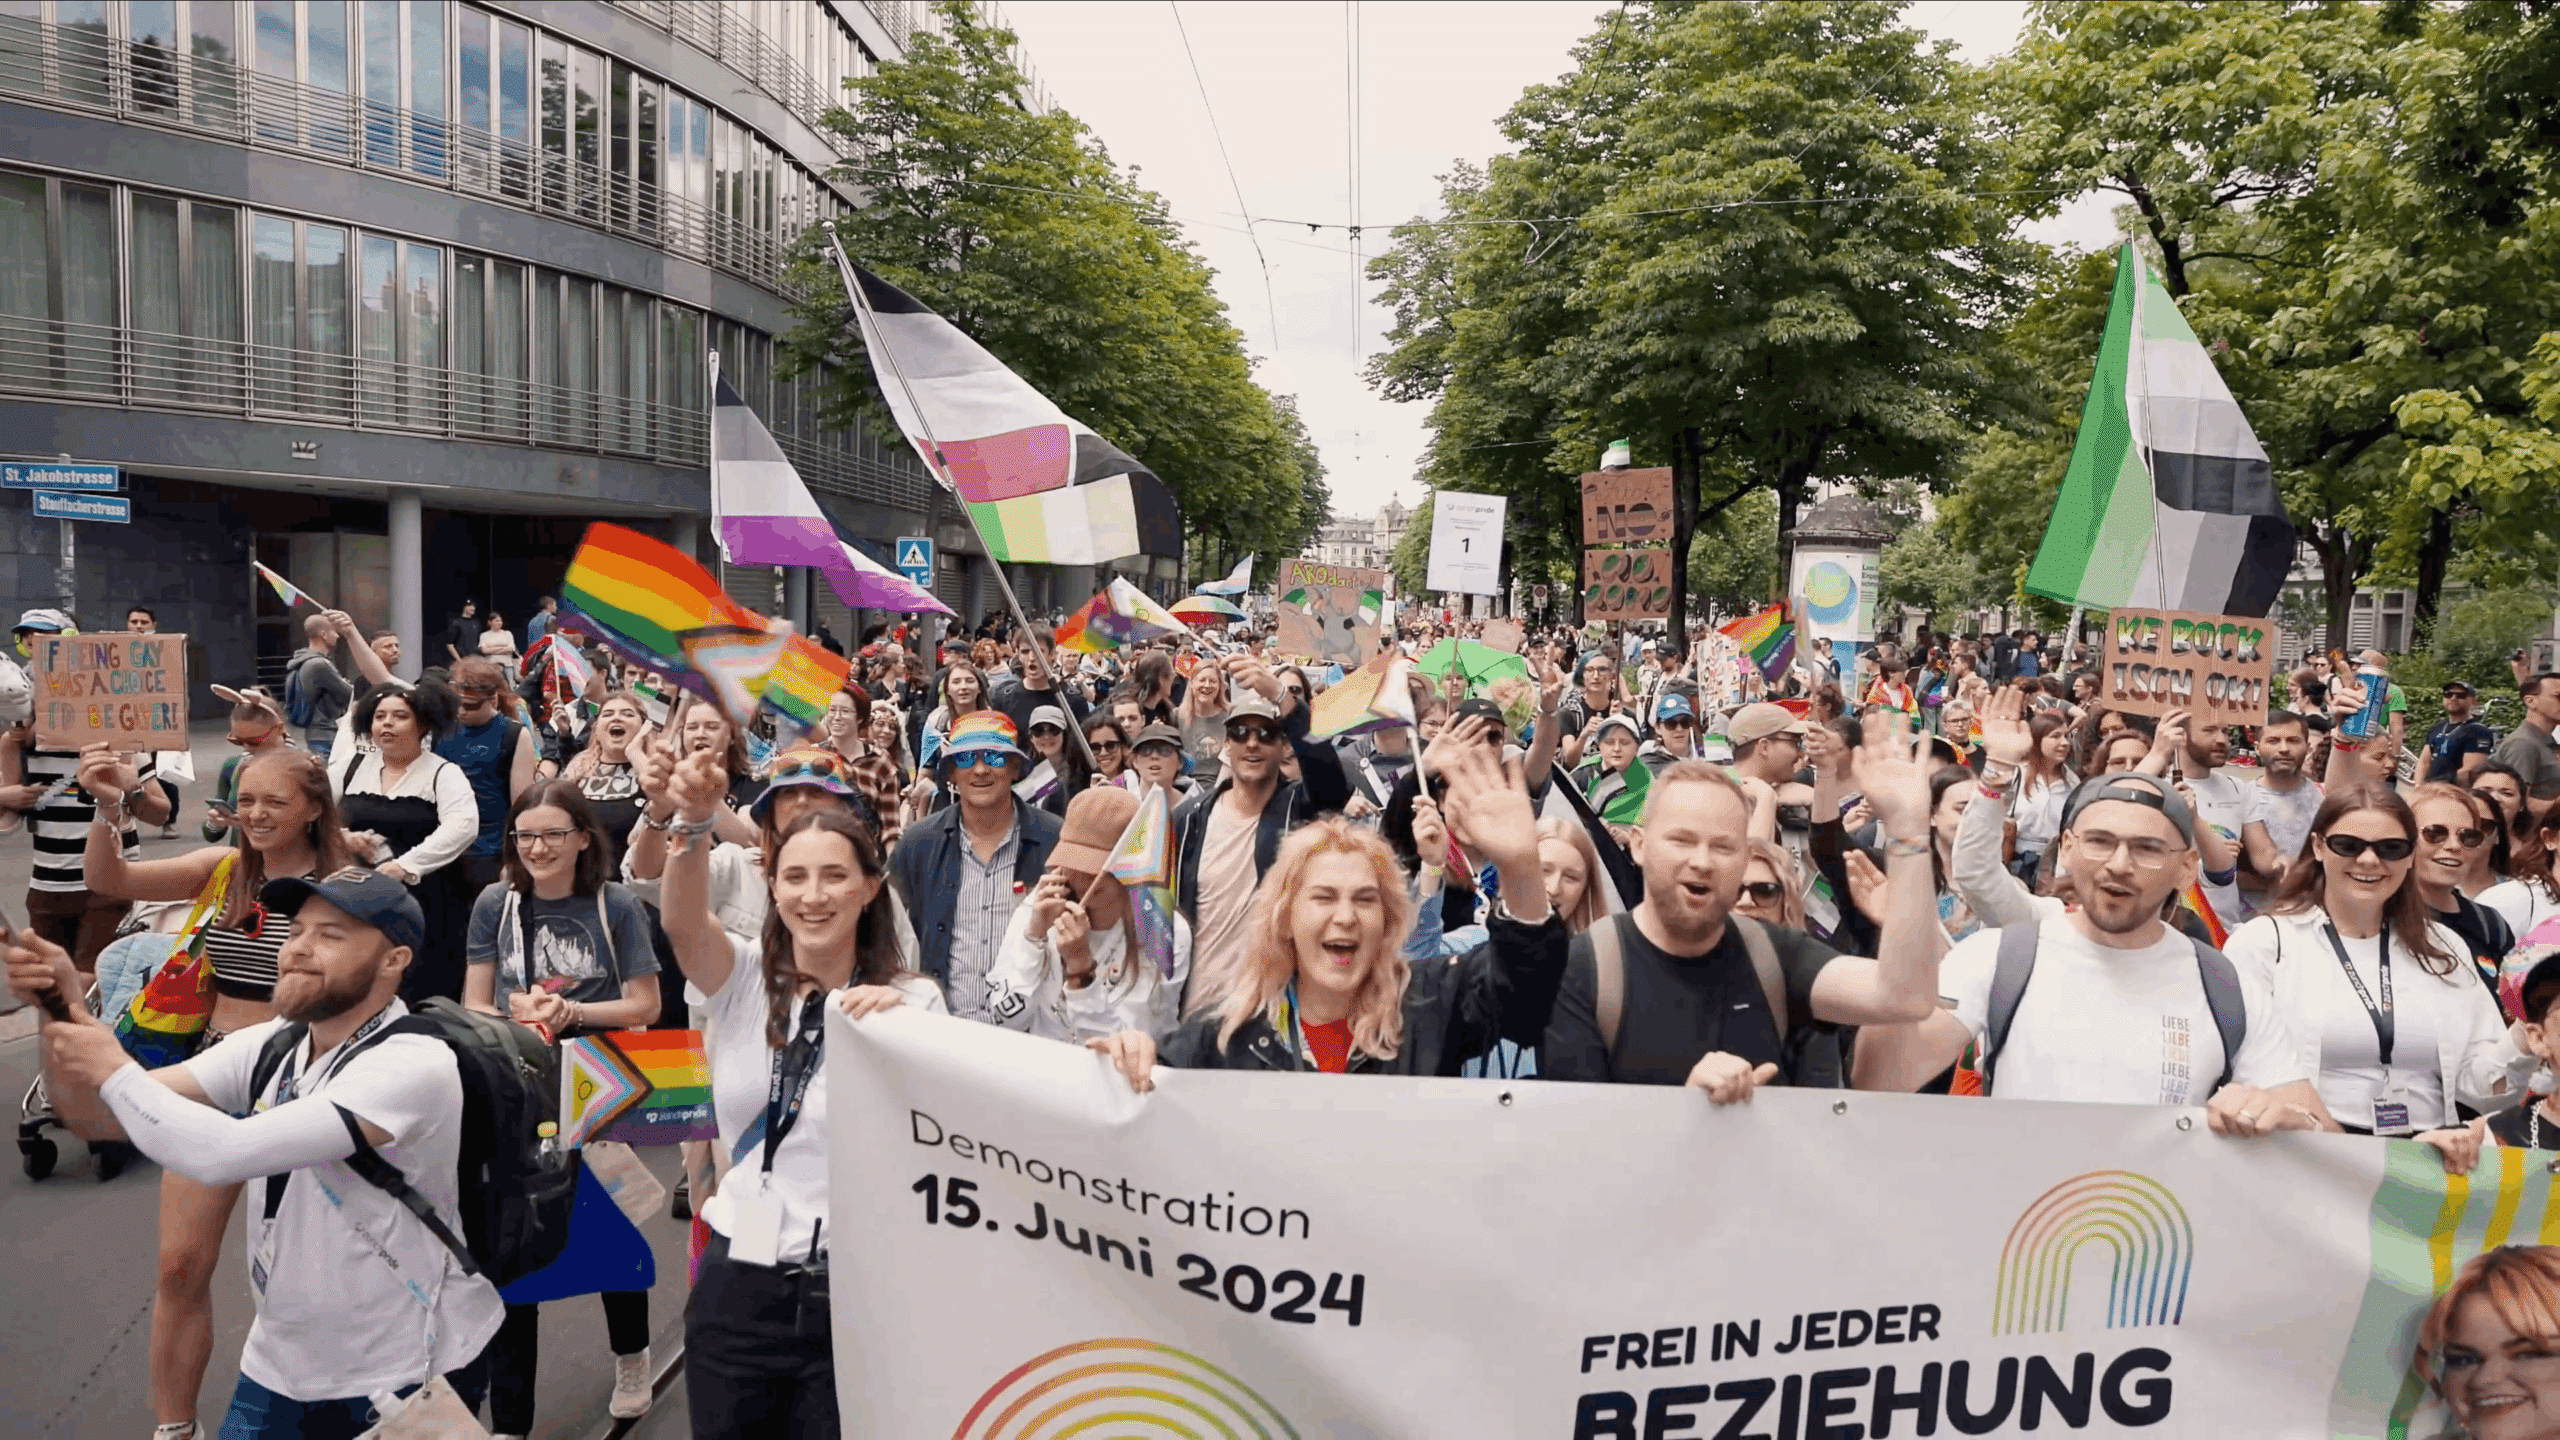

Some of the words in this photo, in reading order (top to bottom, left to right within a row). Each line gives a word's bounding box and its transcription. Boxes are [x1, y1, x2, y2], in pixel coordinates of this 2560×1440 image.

[5, 467, 22, 482] St.
[26, 468, 113, 485] Jakobstrasse
[1596, 503, 1657, 538] NO
[1461, 537, 1470, 554] 1
[40, 640, 61, 673] IF
[67, 641, 121, 670] BEING
[129, 639, 165, 669] GAY
[2116, 616, 2165, 655] KE
[2171, 618, 2264, 664] BOCK
[44, 670, 87, 699] WAS
[90, 671, 109, 697] A
[110, 669, 166, 695] CHOICE
[2112, 662, 2195, 707] ISCH
[2205, 671, 2263, 713] OK!
[87, 703, 115, 730] BE
[119, 701, 179, 732] GAYER!
[2161, 1014, 2190, 1032] LIEBE
[2162, 1030, 2190, 1048] LIEBE
[2160, 1078, 2189, 1095] LIEBE
[2161, 1061, 2190, 1080] LIEBE
[910, 1109, 1310, 1239] Demonstration
[912, 1173, 999, 1232] 15.
[1014, 1201, 1154, 1278] Juni
[1176, 1252, 1366, 1327] 2024
[1580, 1326, 1697, 1374] FREI
[1711, 1319, 1761, 1362] IN
[1774, 1303, 1942, 1354] JEDER
[1573, 1346, 2173, 1440] BEZIEHUNG
